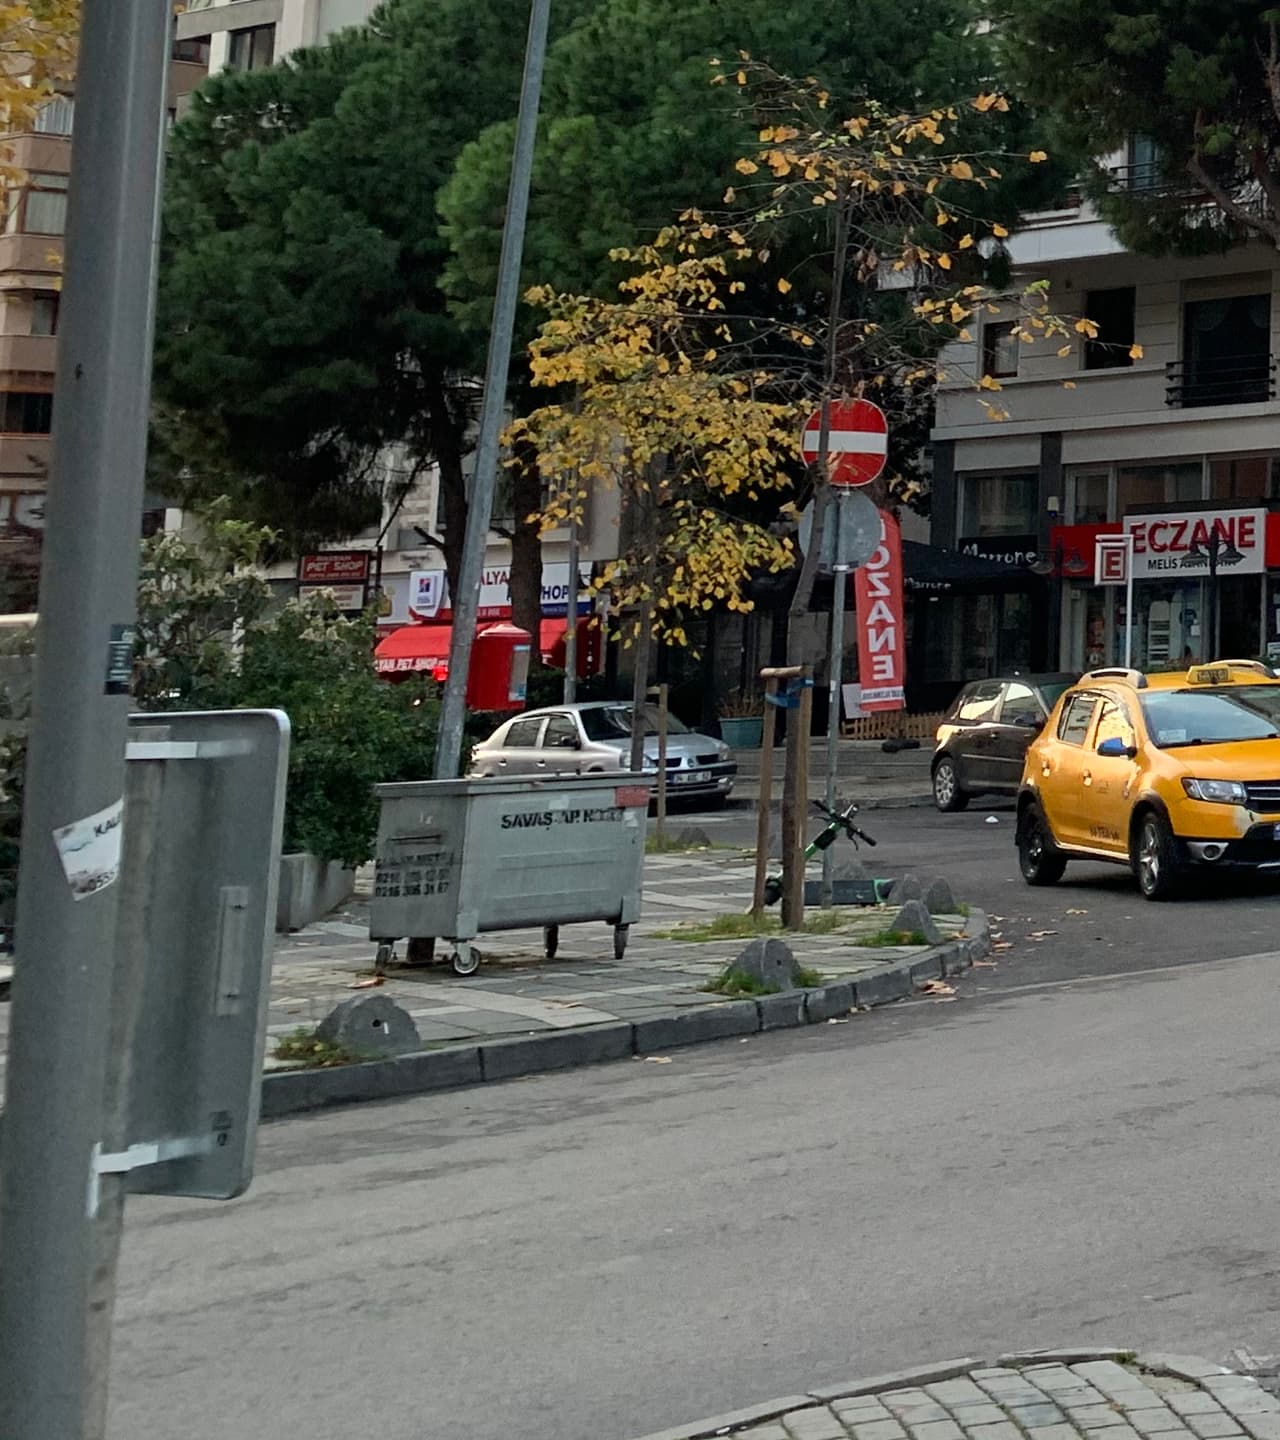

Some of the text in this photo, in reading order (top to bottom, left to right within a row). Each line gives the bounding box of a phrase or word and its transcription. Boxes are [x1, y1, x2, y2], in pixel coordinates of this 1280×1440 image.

[1128, 515, 1256, 554] ECZANE
[963, 543, 1038, 566] Marrone
[306, 560, 363, 572] PET SHOP
[501, 811, 553, 831] SAVAŞ
